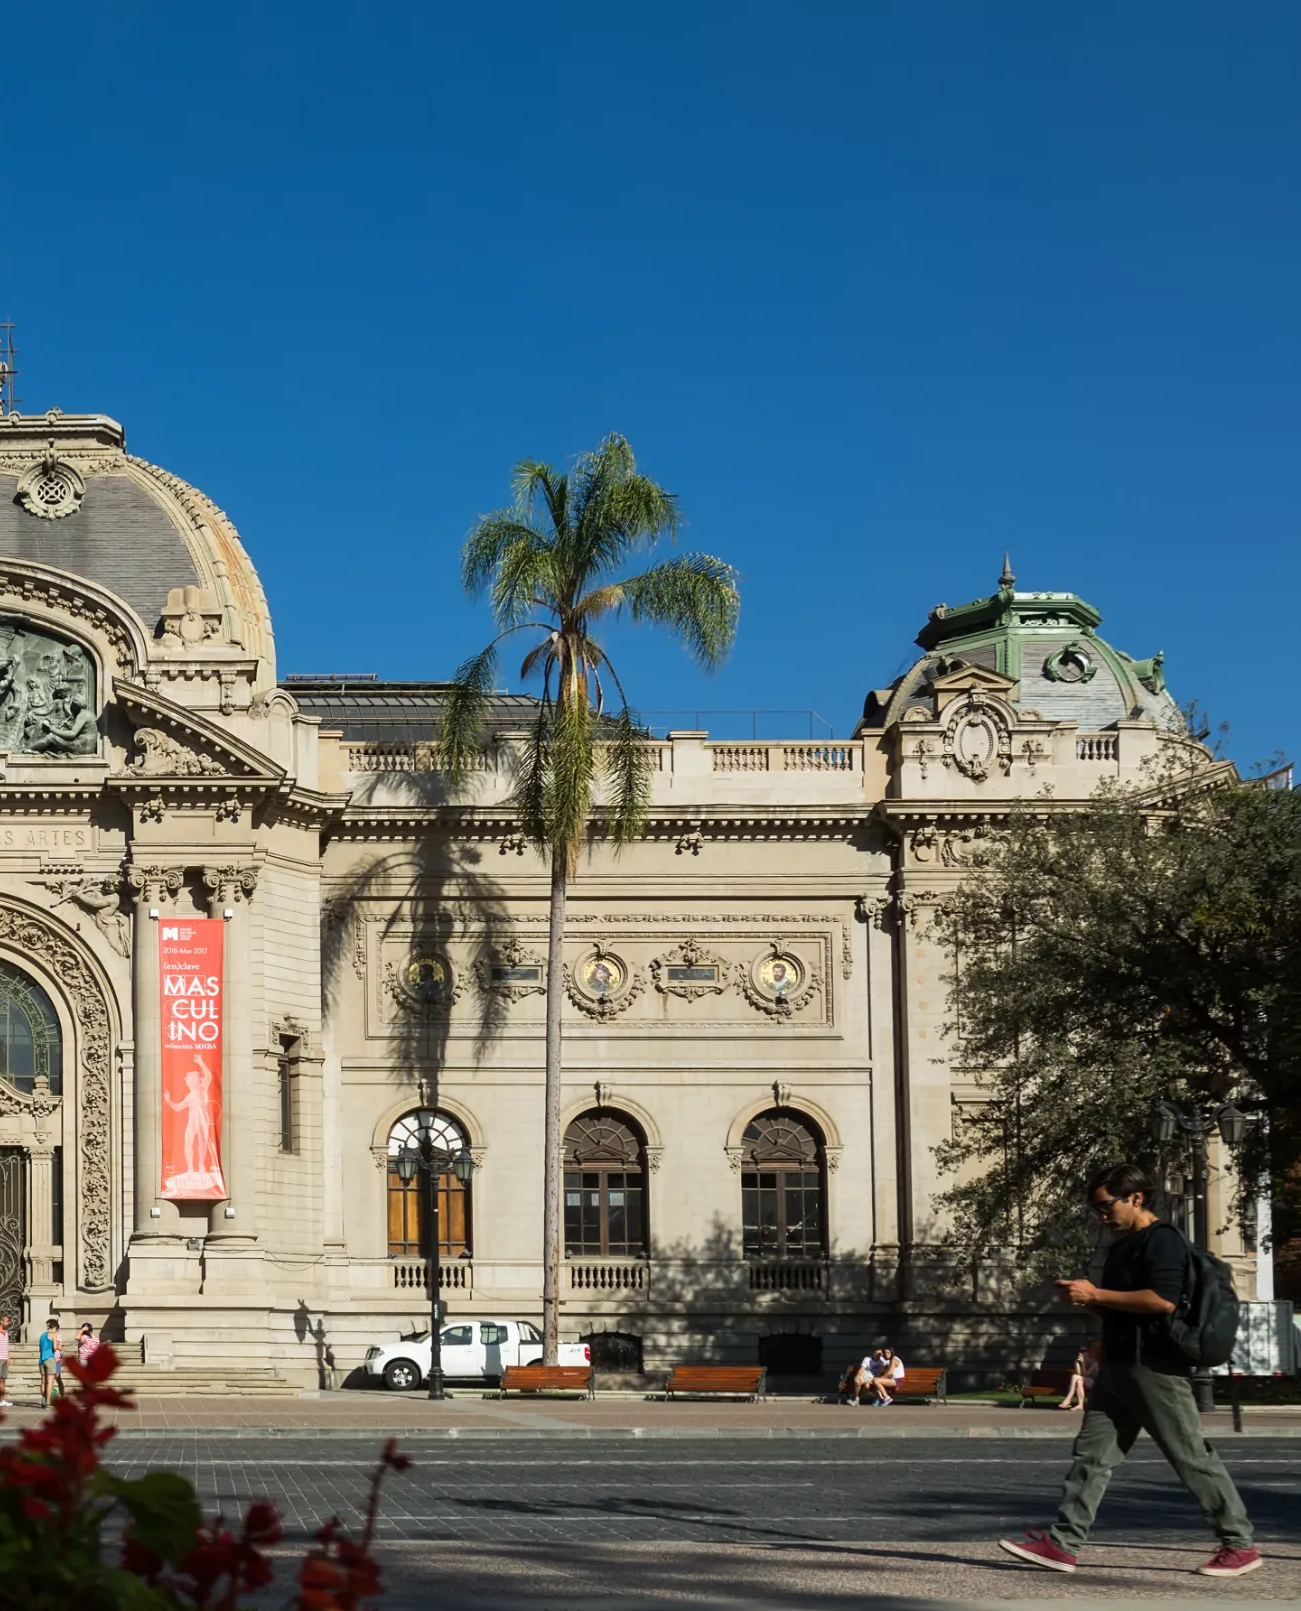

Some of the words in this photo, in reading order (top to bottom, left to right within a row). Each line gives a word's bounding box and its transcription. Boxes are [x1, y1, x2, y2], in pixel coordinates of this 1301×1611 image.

[27, 829, 85, 846] ARTES
[163, 961, 200, 970] (en)clave
[164, 976, 219, 996] MAS
[172, 999, 219, 1019] CUL
[169, 1021, 219, 1041] INO
